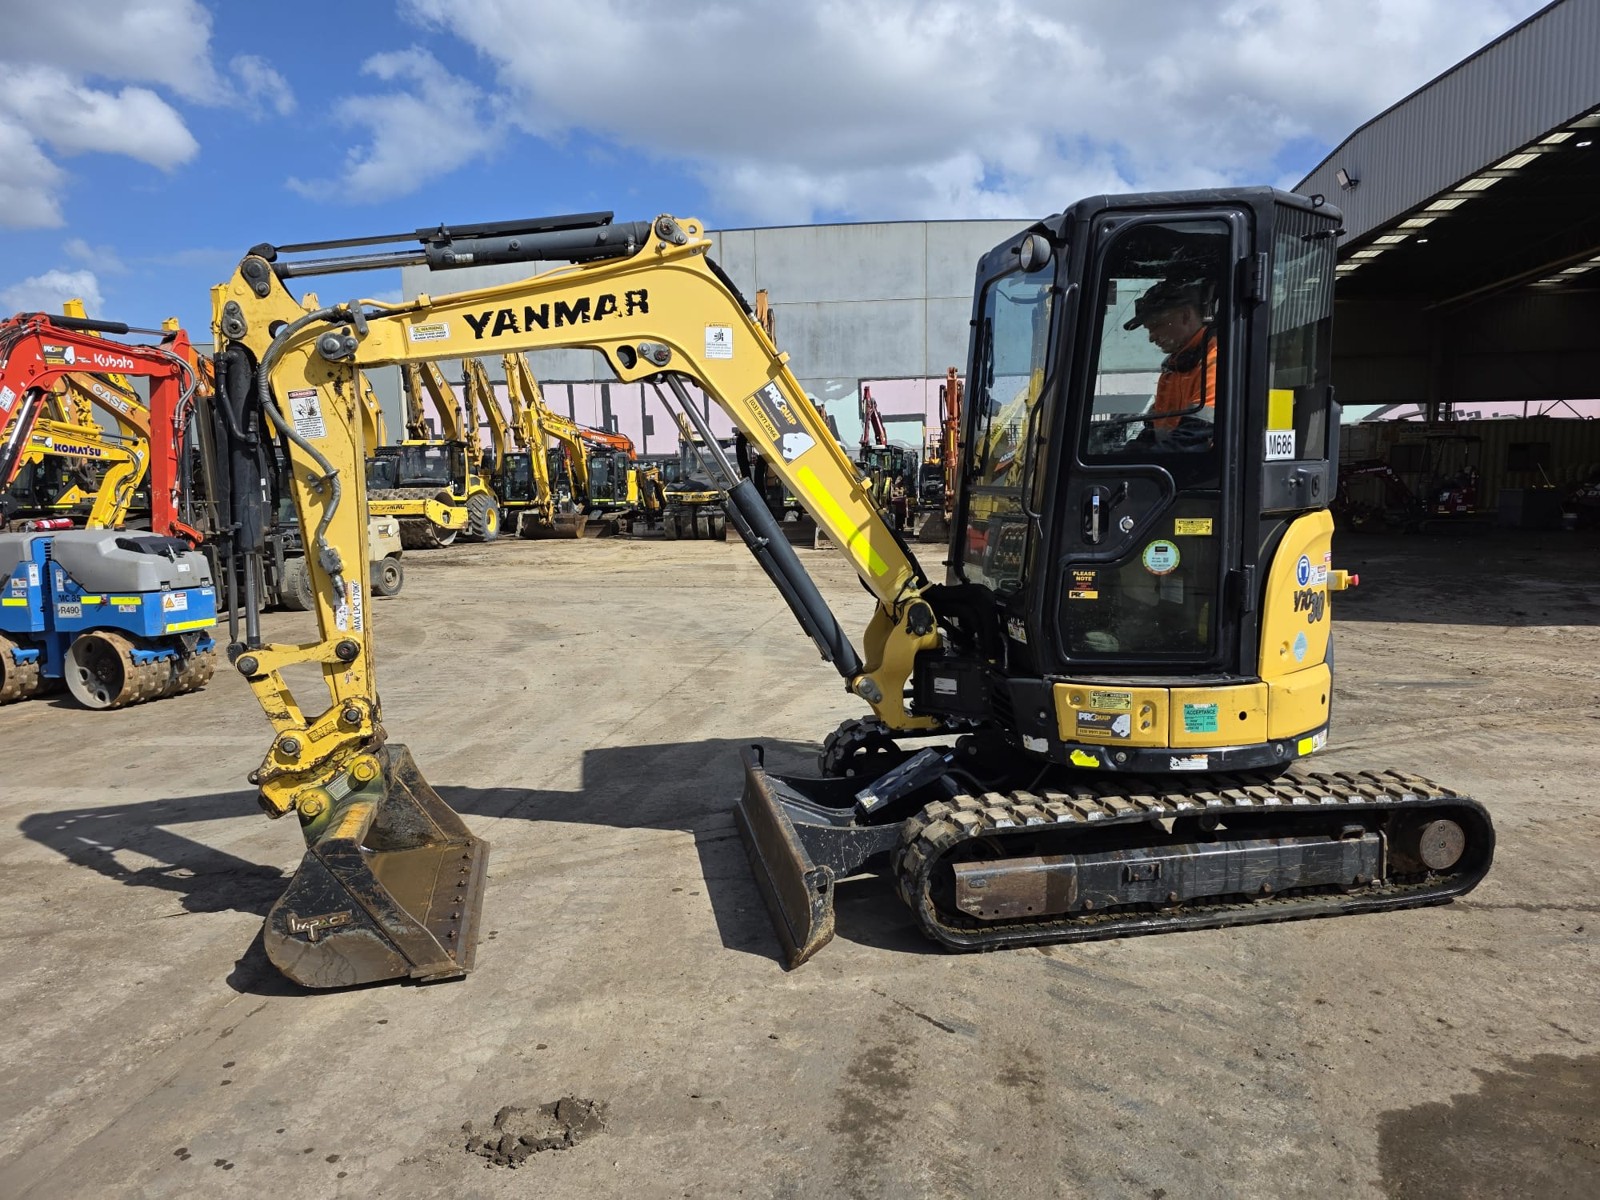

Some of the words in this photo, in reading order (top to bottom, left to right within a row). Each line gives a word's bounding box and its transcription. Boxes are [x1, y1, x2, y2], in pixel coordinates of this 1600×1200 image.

[463, 289, 649, 339] YANMAR
[94, 353, 134, 369] Kubota
[92, 382, 129, 413] CASE
[54, 443, 101, 456] KOMATSU
[1269, 435, 1293, 455] M686
[60, 606, 80, 615] R490
[292, 915, 347, 939] IMPACT
